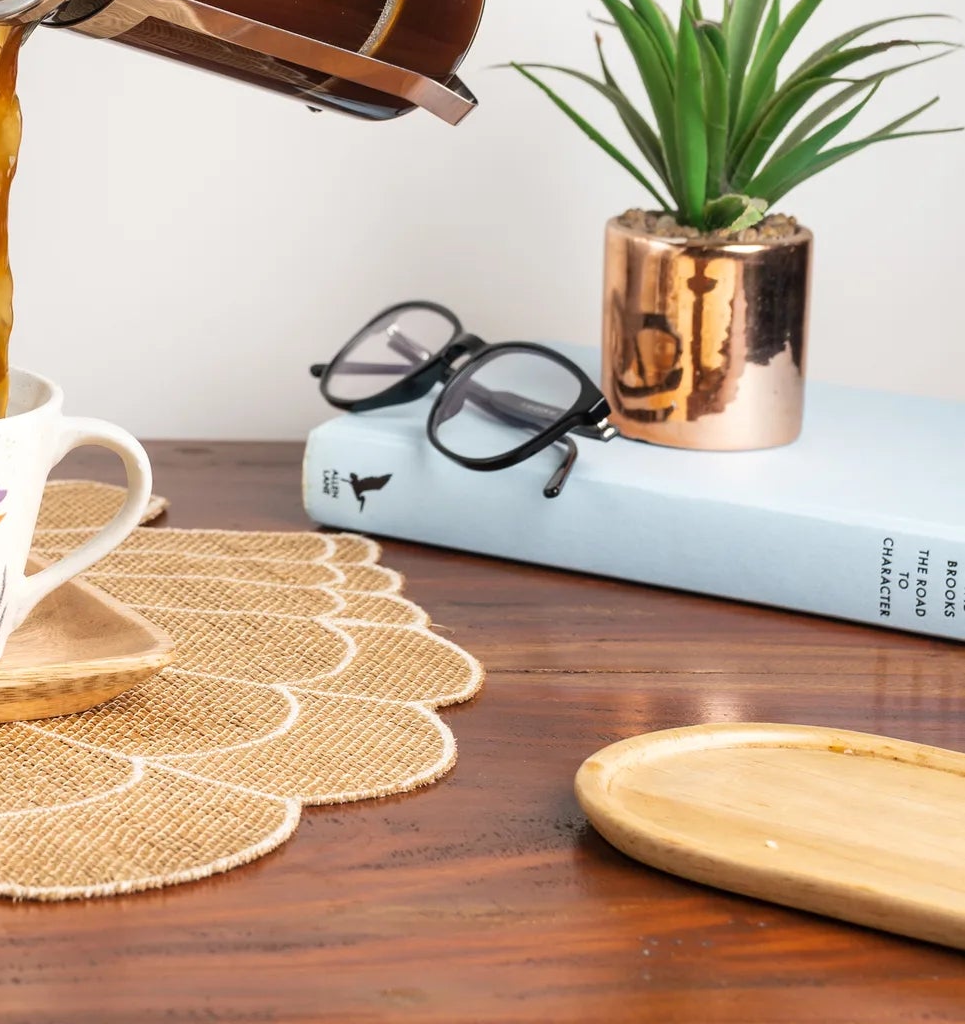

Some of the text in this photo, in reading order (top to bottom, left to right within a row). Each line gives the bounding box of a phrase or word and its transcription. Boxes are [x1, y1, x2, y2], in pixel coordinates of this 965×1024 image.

[879, 537, 894, 617] CHARACTER
[898, 572, 910, 590] TO
[915, 550, 930, 617] THE ROAD
[944, 560, 958, 618] BROOKS
